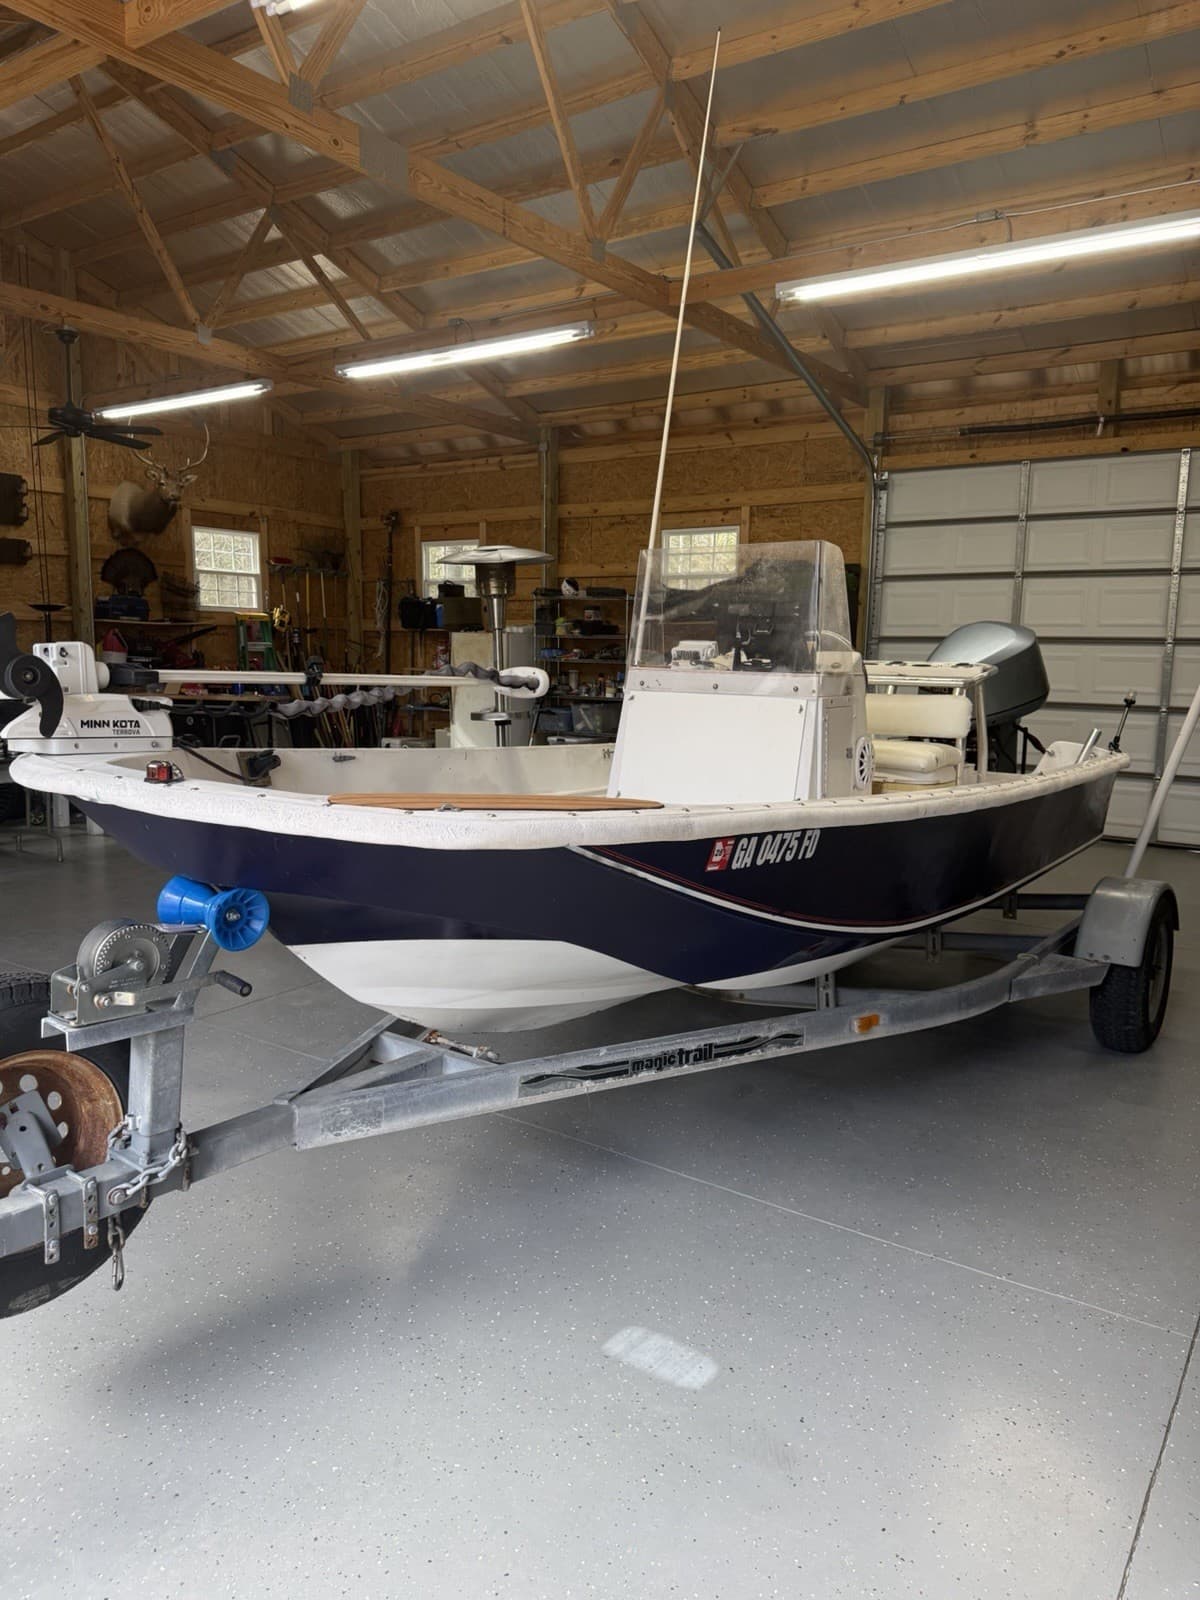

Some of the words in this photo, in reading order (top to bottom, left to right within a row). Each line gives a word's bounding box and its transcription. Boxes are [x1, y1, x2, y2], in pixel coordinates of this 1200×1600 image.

[80, 719, 110, 729] MINN
[112, 719, 141, 729] KOTA
[731, 837, 758, 870] GA
[756, 831, 802, 866] 0475
